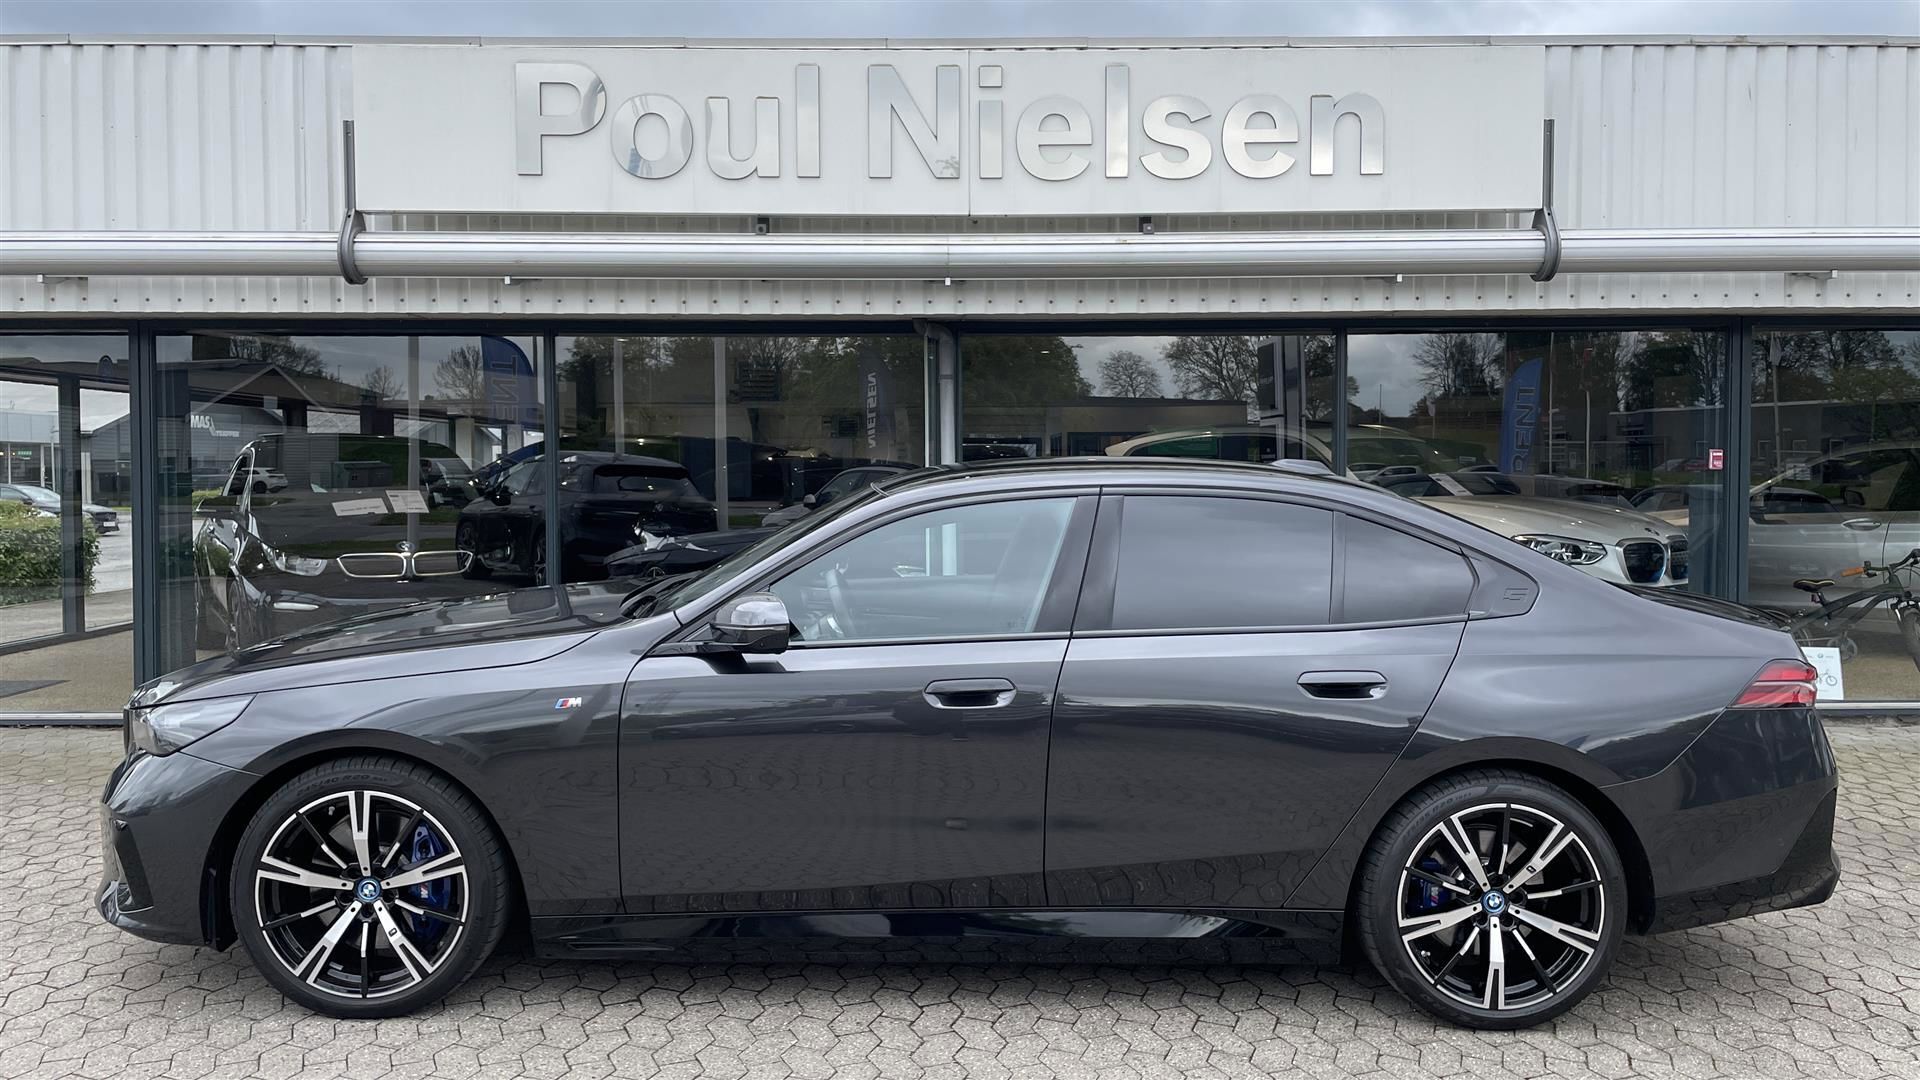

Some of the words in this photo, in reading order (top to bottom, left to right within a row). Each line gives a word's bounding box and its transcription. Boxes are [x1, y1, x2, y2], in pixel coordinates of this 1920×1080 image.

[514, 61, 821, 180] Poul
[867, 63, 1386, 182] Nielsen
[1511, 386, 1536, 473] RENT
